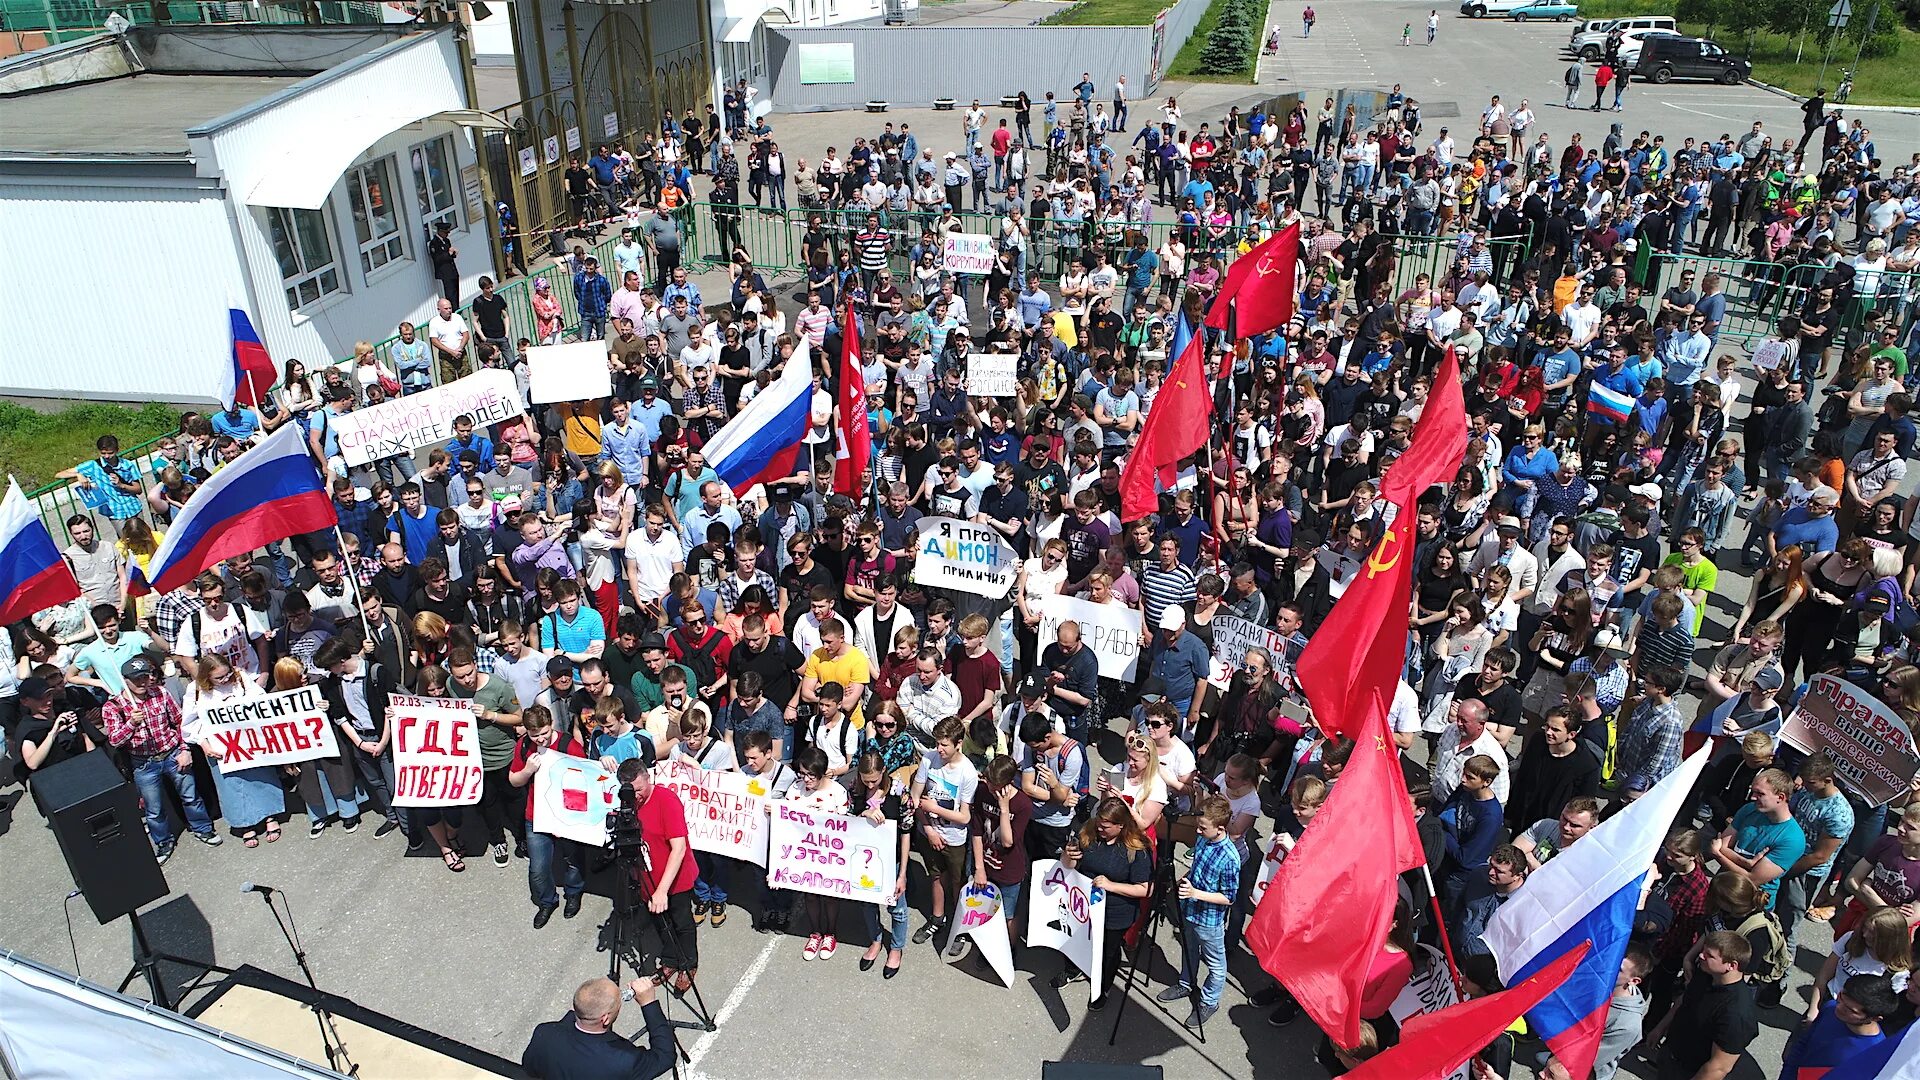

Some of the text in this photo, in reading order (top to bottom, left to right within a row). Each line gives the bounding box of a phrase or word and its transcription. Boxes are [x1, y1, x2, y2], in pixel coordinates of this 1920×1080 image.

[341, 408, 433, 448] СПАЛЬНОМ
[366, 423, 446, 461] ВАЖНЕЕ
[940, 522, 951, 538] Я
[943, 565, 1006, 585] ПРИЛИЧИЯ
[1213, 616, 1287, 655] СЕГОДНЯ ТЫ
[1214, 629, 1227, 643] ПО
[207, 690, 315, 725] ПЕРЕМЕН-ТО
[214, 717, 324, 764] ЖДАТЬ?
[398, 717, 469, 757] ГДЕ
[1798, 708, 1906, 793] кремлевских
[1834, 714, 1886, 757] выше
[398, 765, 482, 800] ОТВЕТЫ?
[801, 832, 844, 850] ДНО
